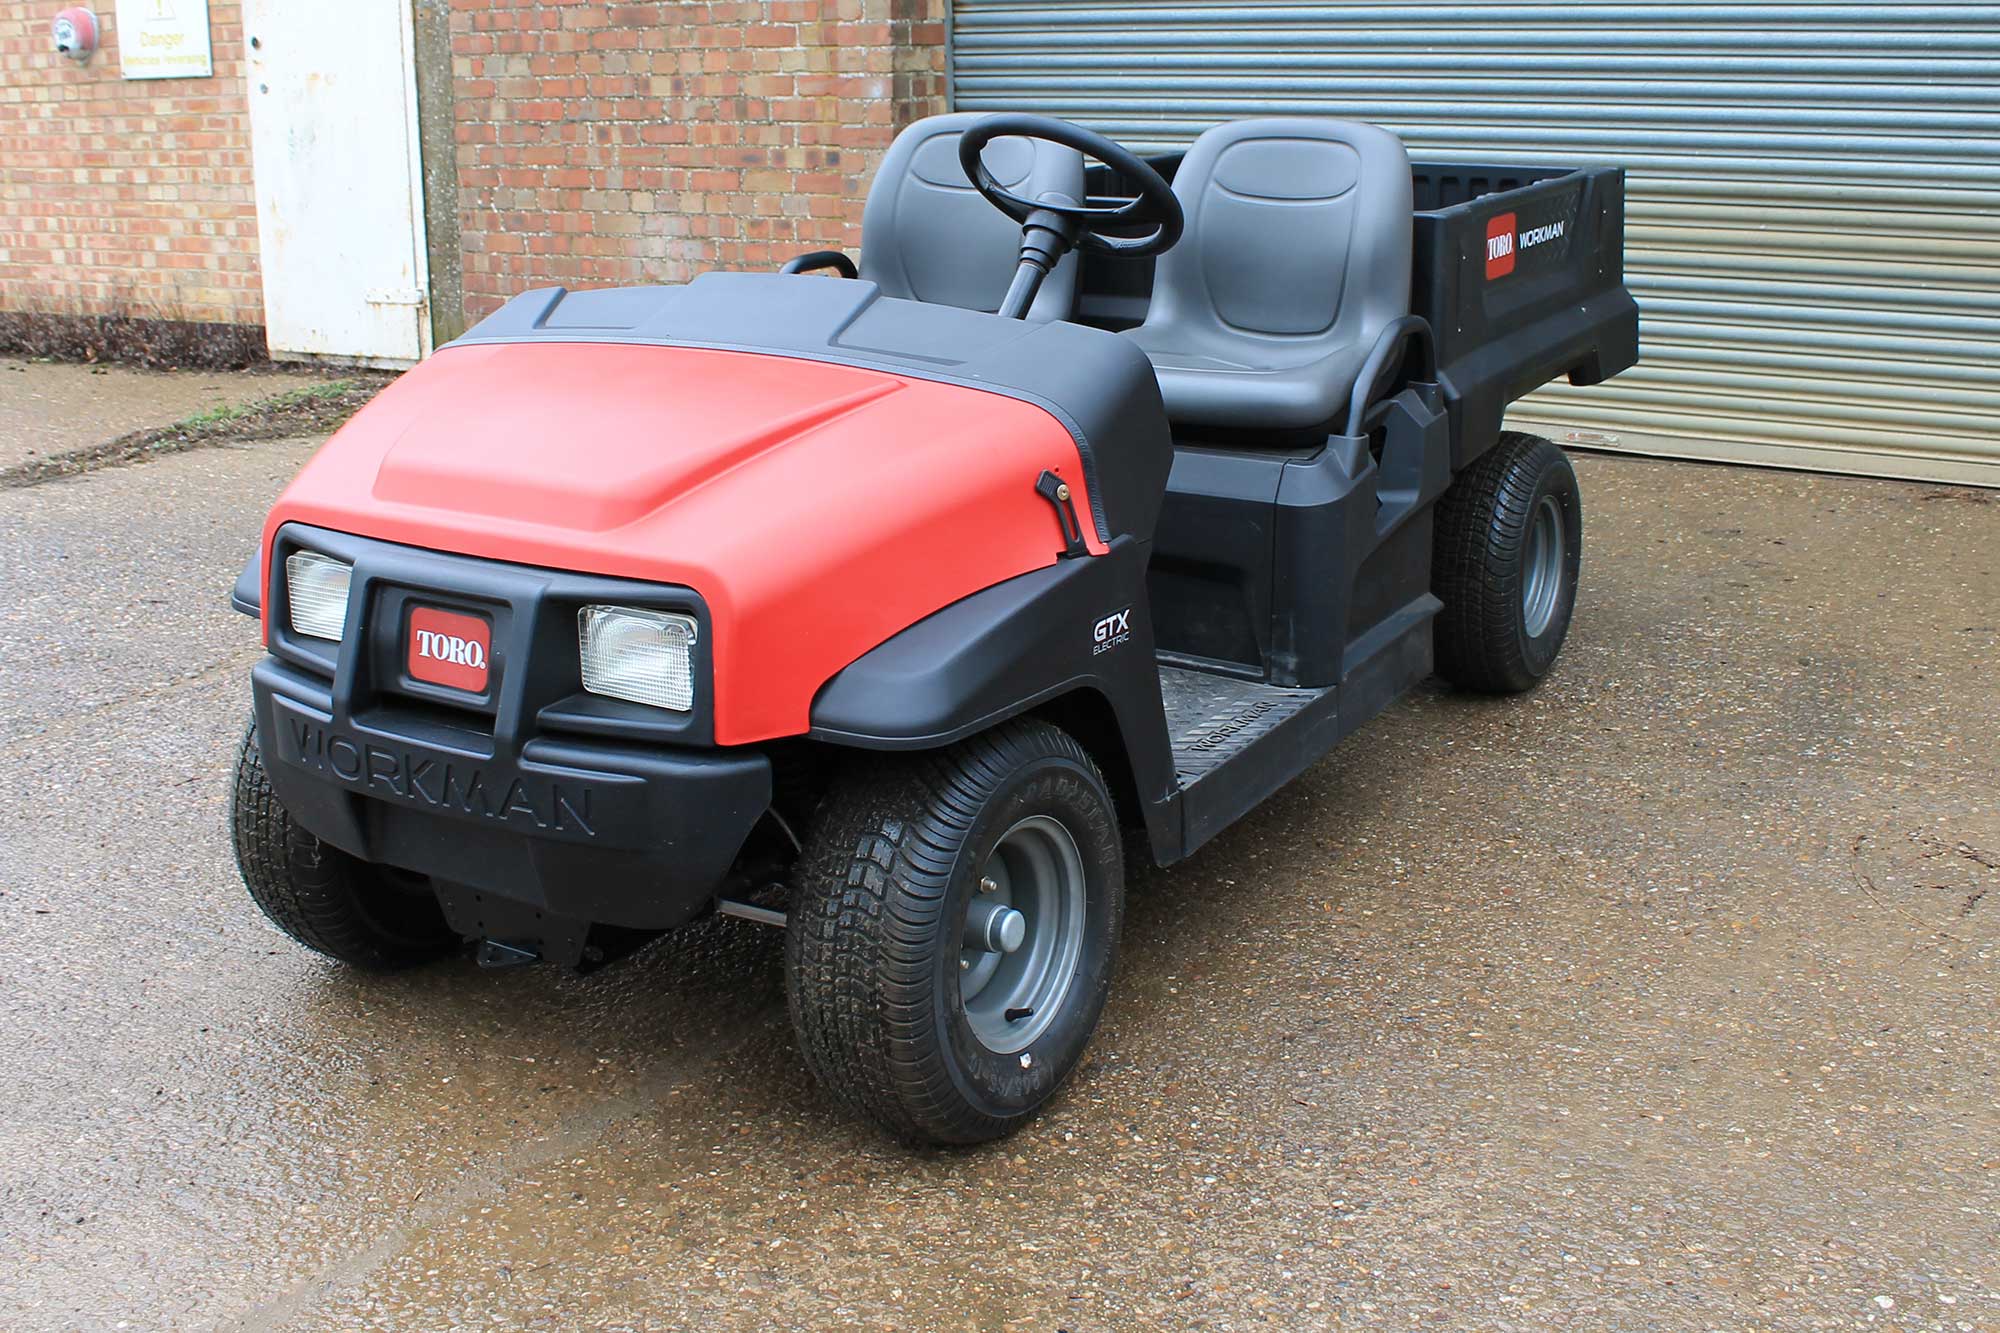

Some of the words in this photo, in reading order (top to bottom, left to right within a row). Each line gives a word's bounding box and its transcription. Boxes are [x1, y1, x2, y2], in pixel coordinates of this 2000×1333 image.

[140, 31, 184, 50] Danger
[1487, 232, 1513, 261] TORO
[1520, 221, 1564, 249] WORKMAN
[1093, 631, 1129, 656] ELECTRIC
[1094, 609, 1130, 642] GTX
[416, 629, 486, 669] TORO
[1189, 702, 1278, 751] WORKMAN
[289, 717, 597, 836] WORKMAN
